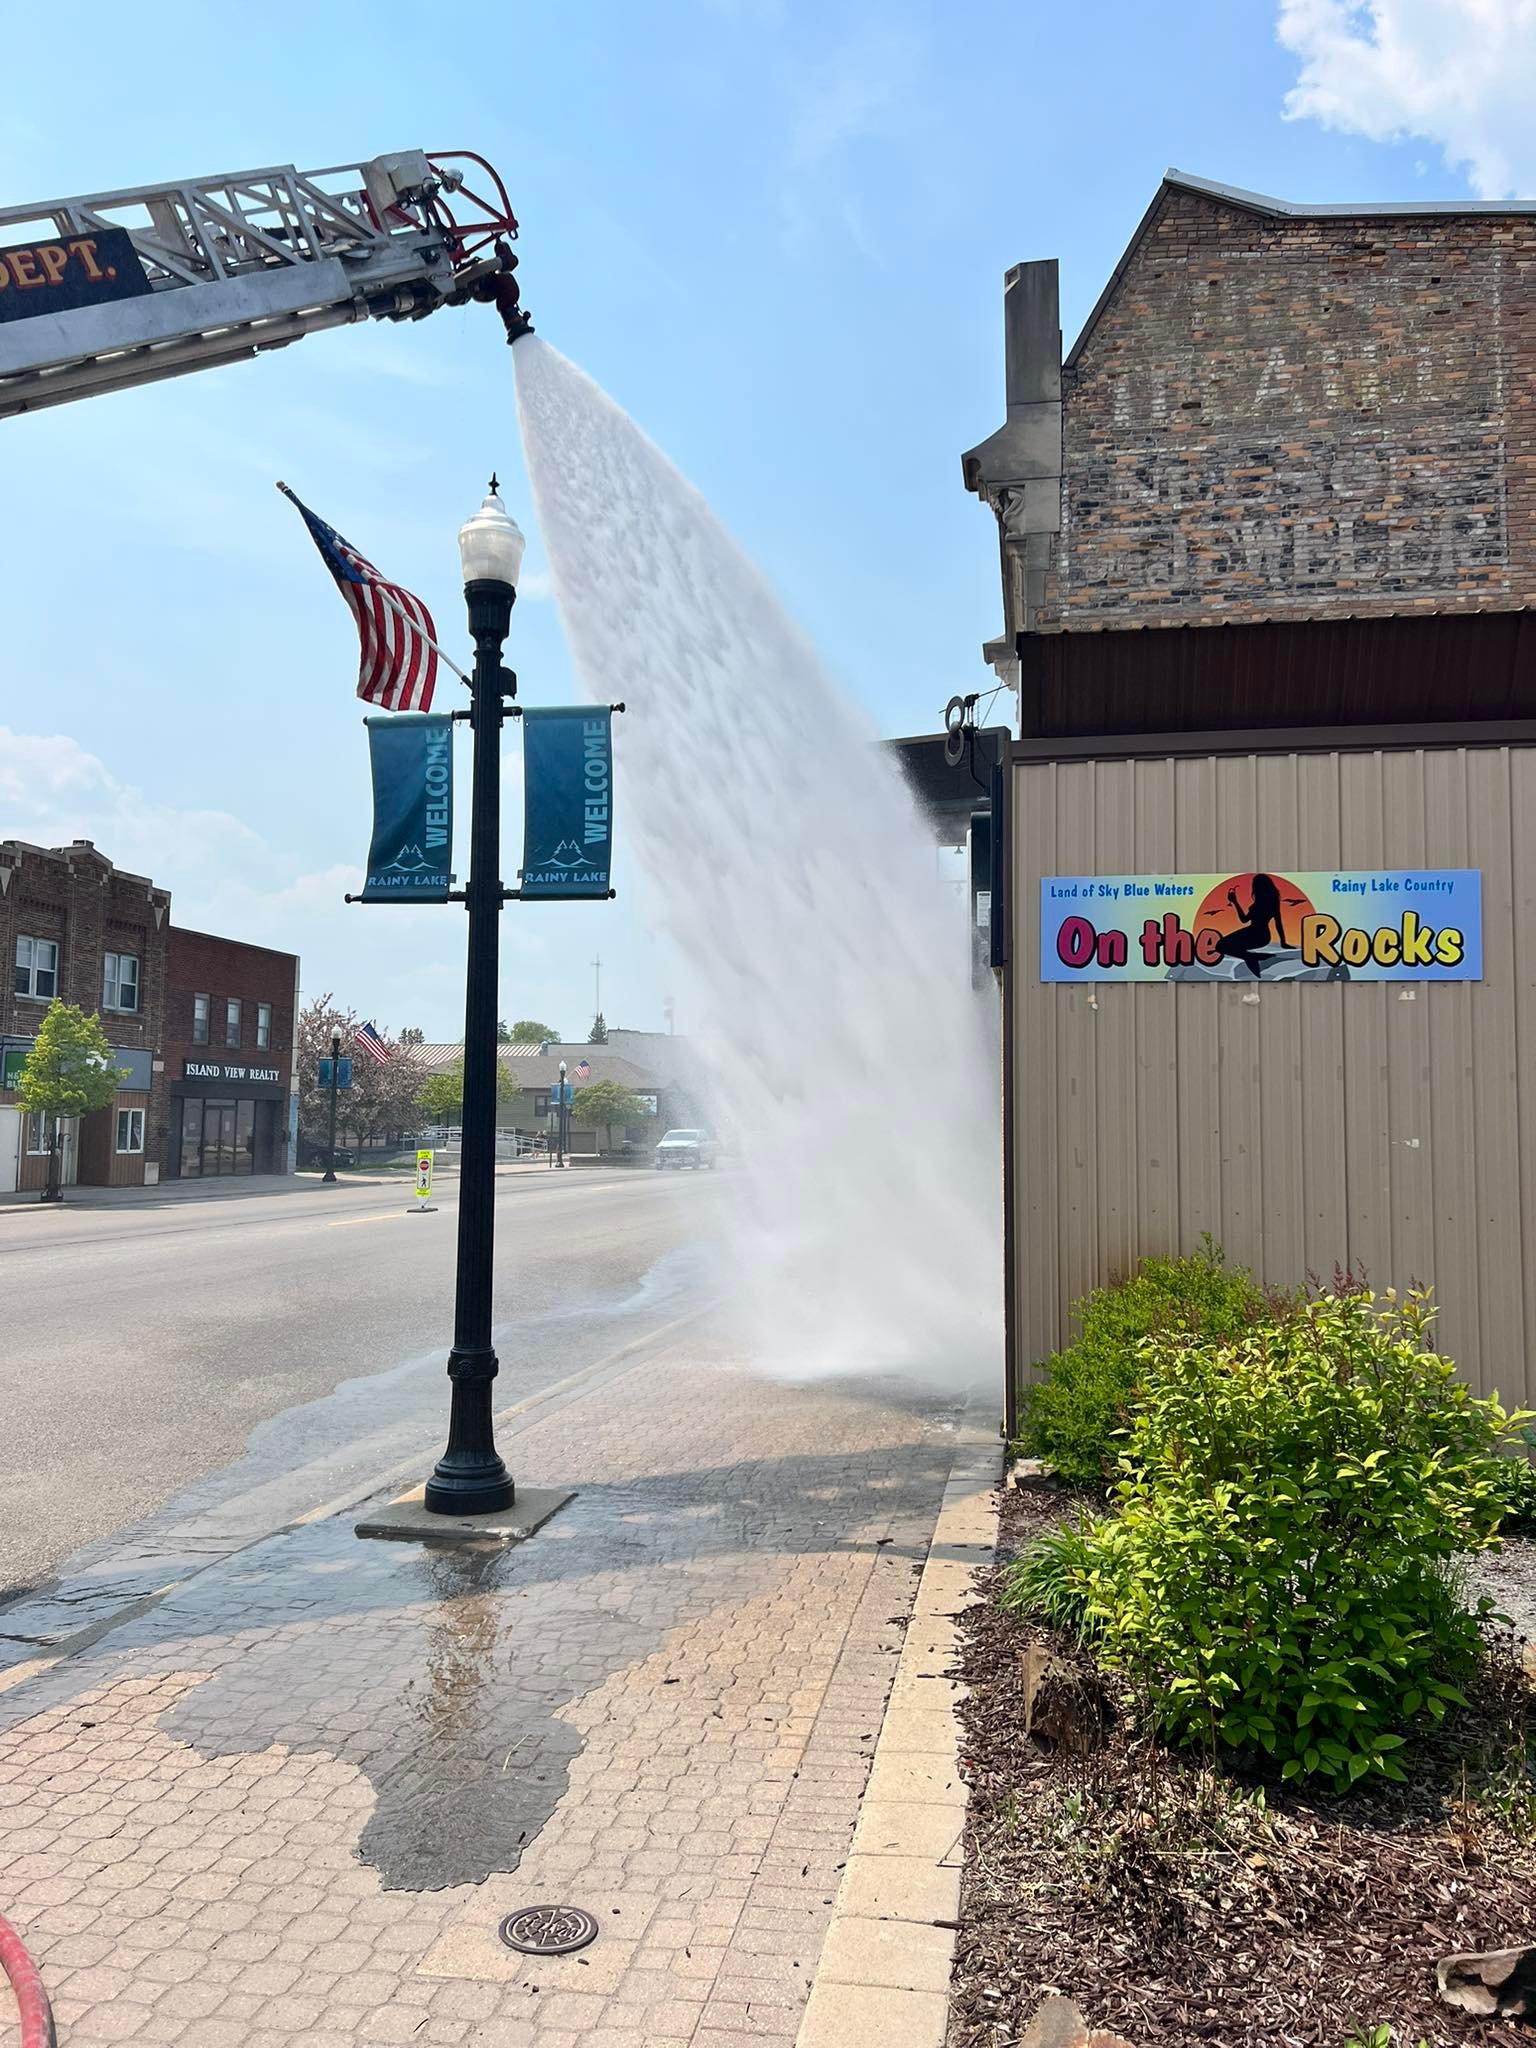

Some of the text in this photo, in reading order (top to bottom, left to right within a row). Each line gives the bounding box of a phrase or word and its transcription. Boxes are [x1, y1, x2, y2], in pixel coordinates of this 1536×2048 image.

[425, 727, 449, 849] WELCOME
[583, 721, 608, 845] WELCOME
[368, 874, 448, 886] RAINY LAKE
[525, 871, 607, 883] RAINY LAKE
[1051, 883, 1194, 900] Land of Sky Blue Waters
[1332, 878, 1455, 895] Rainy Lake Country
[1056, 910, 1465, 968] On the Rocks
[186, 1063, 280, 1080] ISLAND VIEW REALTY
